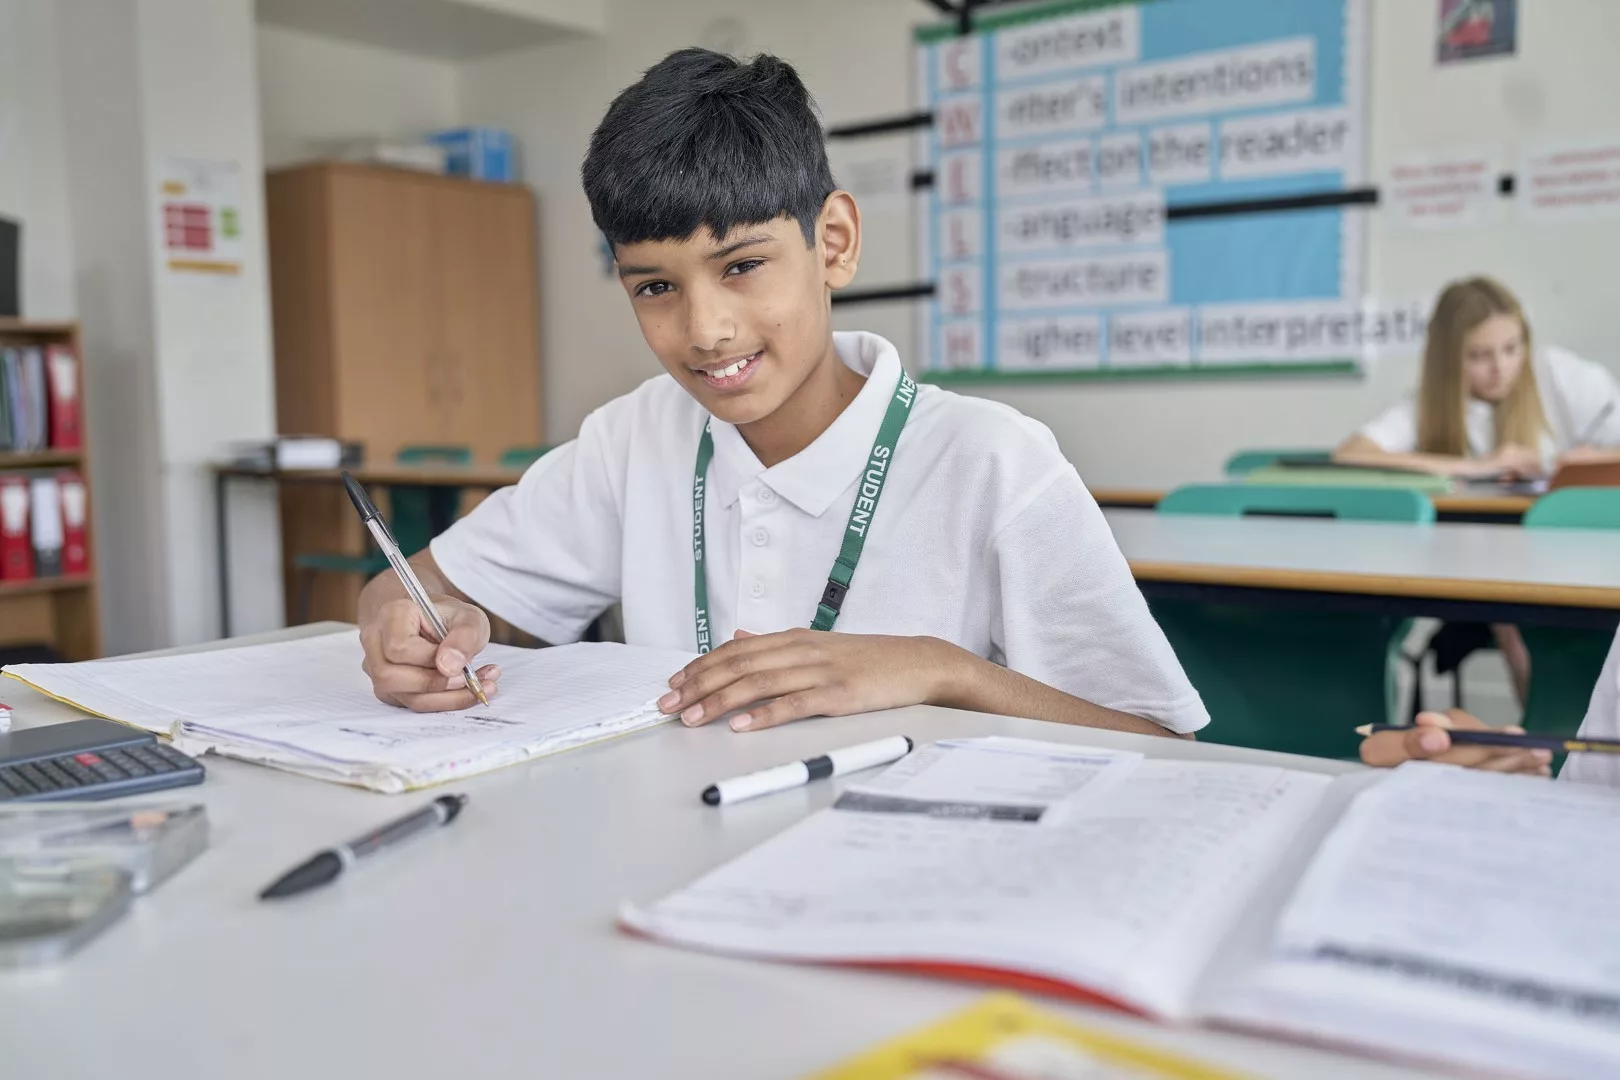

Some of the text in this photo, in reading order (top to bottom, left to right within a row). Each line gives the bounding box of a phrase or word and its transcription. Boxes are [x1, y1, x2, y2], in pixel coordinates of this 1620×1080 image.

[1119, 53, 1313, 106] intentions
[1149, 131, 1209, 170] the
[1220, 116, 1347, 163] reader
[694, 475, 704, 561] STUDENT
[849, 445, 890, 537] STUDENT
